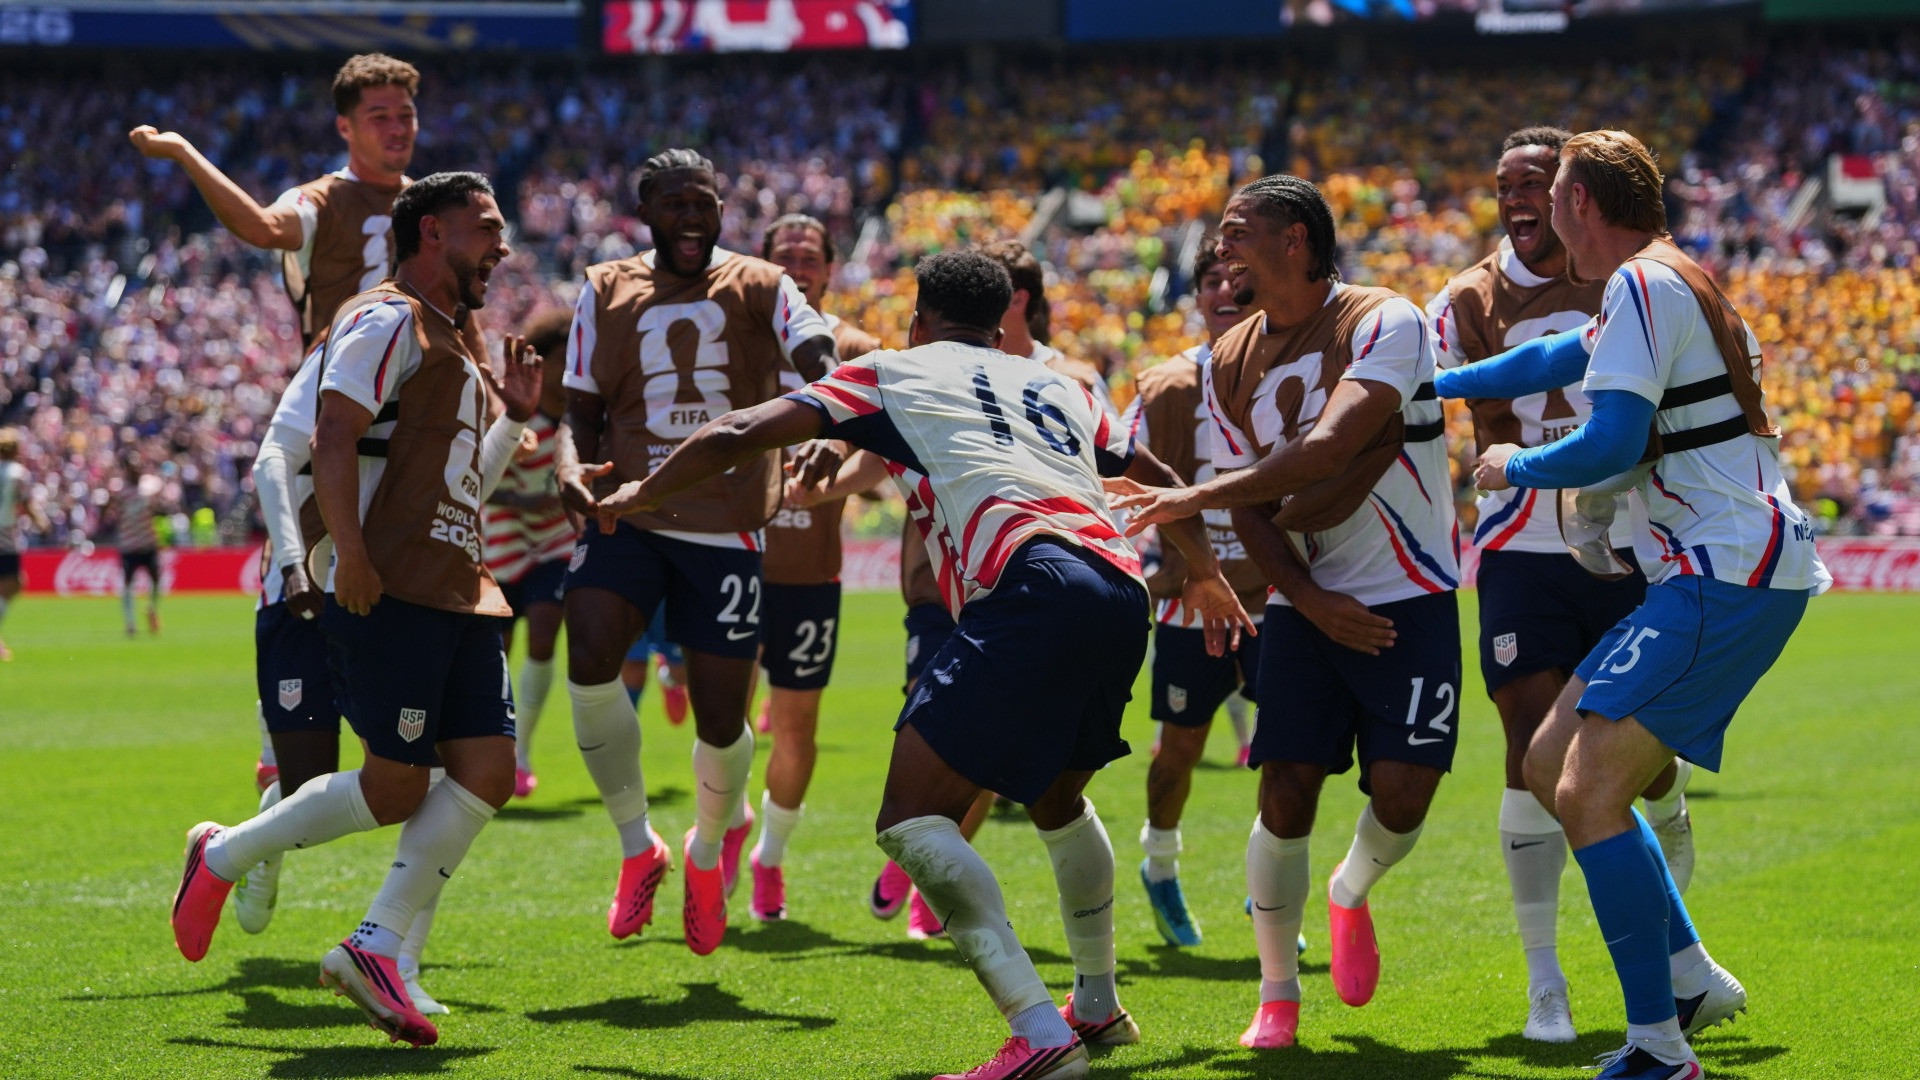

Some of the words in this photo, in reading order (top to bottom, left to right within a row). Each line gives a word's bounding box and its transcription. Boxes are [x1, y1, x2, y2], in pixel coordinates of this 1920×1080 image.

[670, 410, 710, 425] FIFA
[962, 365, 1081, 456] 16
[1543, 424, 1578, 441] FIF
[768, 509, 812, 528] 26
[716, 574, 761, 624] 22
[788, 618, 836, 662] 23
[402, 710, 424, 724] USA
[1406, 677, 1455, 733] 12
